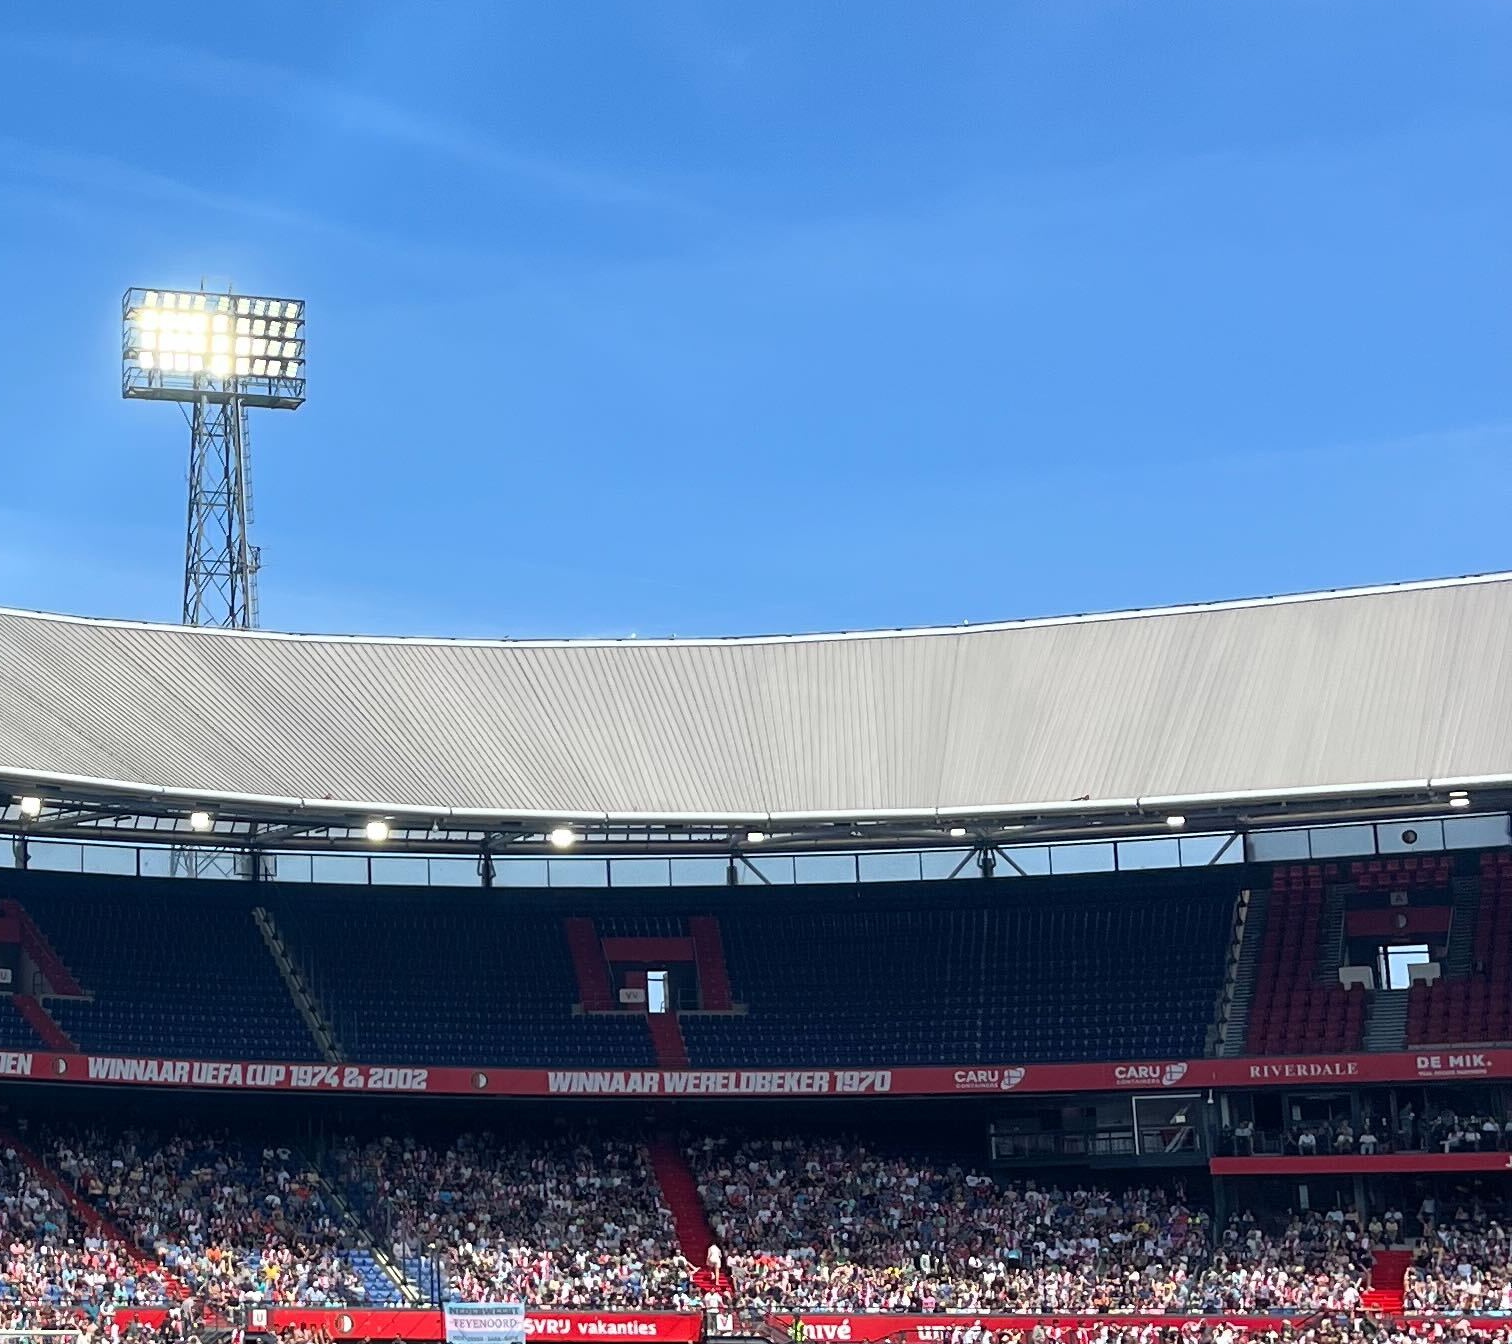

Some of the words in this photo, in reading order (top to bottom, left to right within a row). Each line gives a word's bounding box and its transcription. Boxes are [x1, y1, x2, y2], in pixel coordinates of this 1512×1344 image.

[1250, 1062, 1359, 1078] RIVERDALE
[1416, 1056, 1442, 1069] DE
[88, 1056, 188, 1083] WINNAAR
[192, 1061, 242, 1086] UEFA
[245, 1063, 285, 1087] CUP
[290, 1065, 338, 1089] 1974
[369, 1067, 427, 1090] 2002
[954, 1070, 998, 1083] CARU
[1115, 1066, 1160, 1078] CARU
[547, 1071, 659, 1094] WINNAAR
[663, 1071, 829, 1093] WERELDBEKER
[834, 1070, 891, 1092] 1970
[256, 1311, 265, 1324] U
[578, 1317, 657, 1336] vakanties
[803, 1318, 851, 1340] nivé
